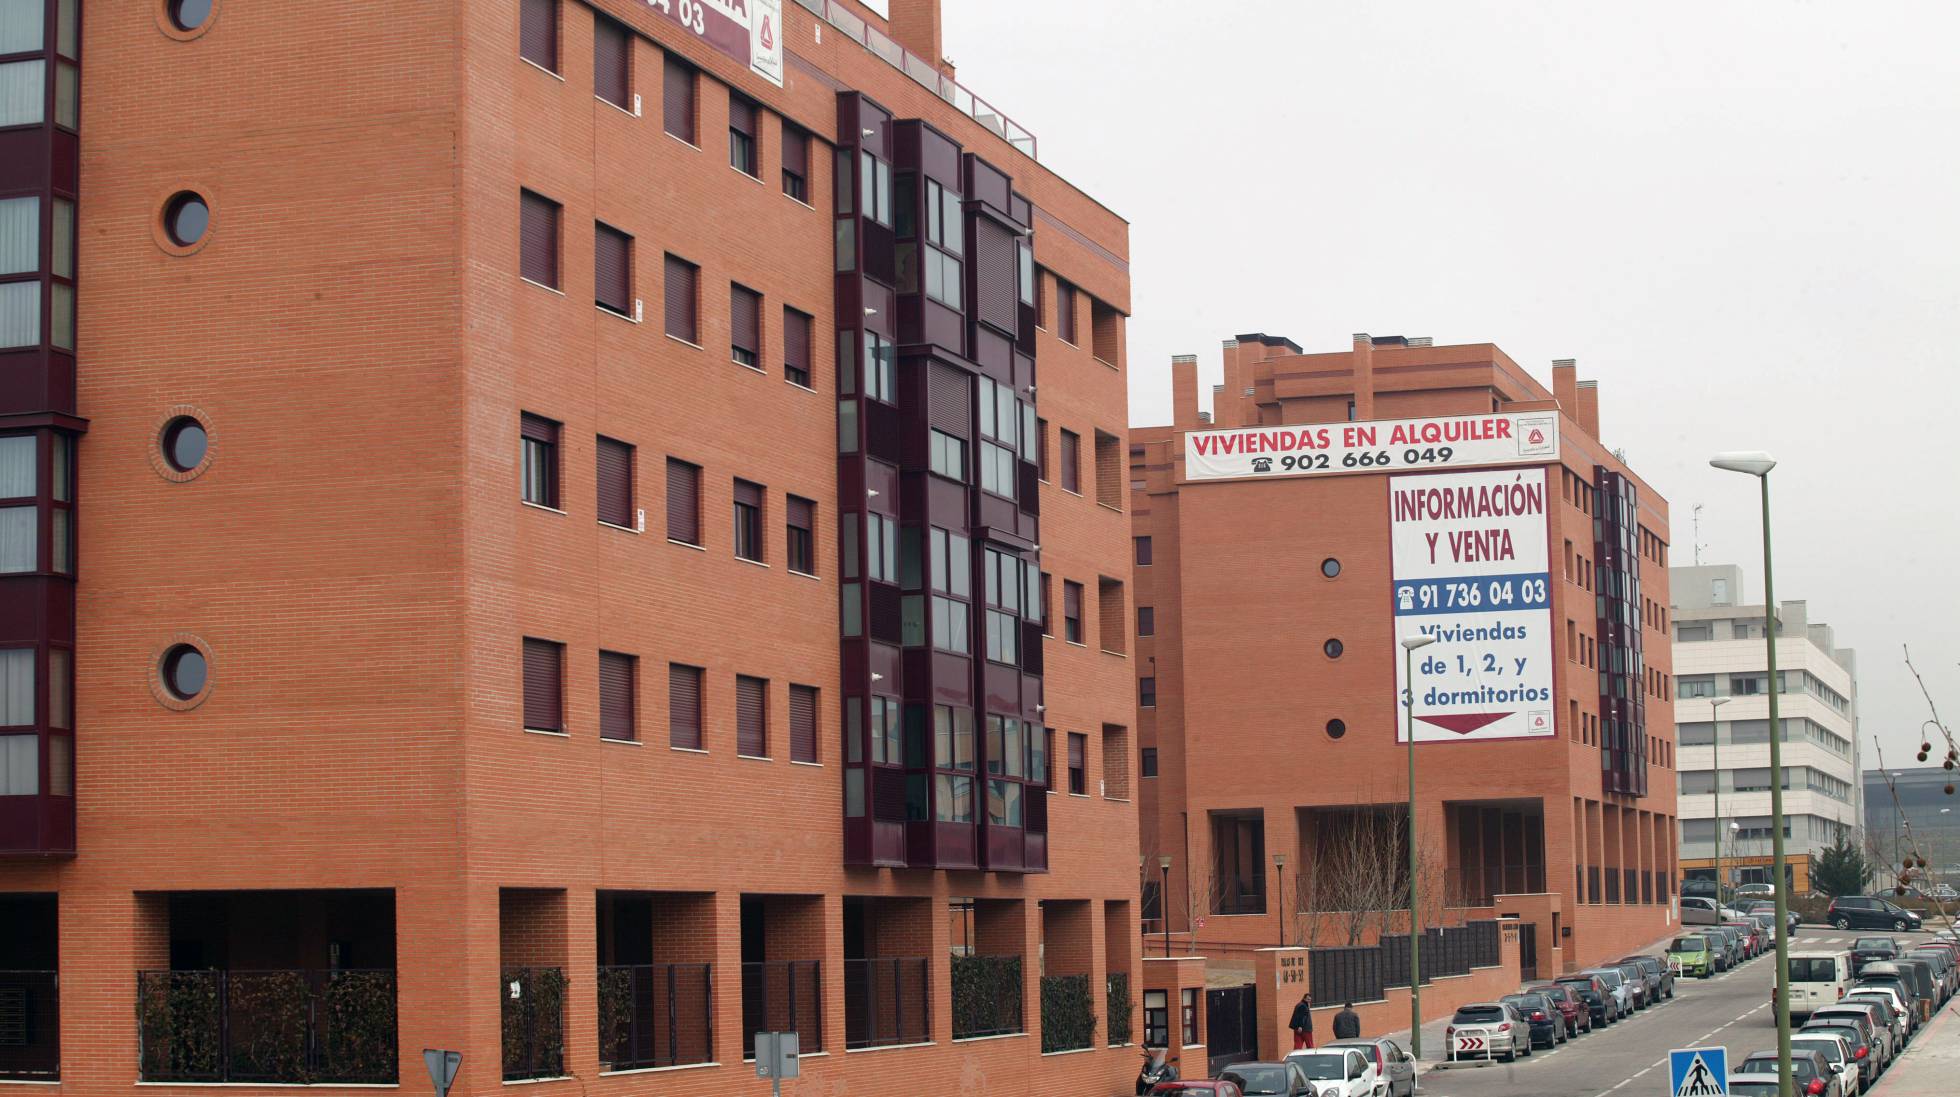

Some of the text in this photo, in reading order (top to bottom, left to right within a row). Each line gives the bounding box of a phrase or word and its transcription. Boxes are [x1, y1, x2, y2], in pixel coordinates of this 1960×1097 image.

[679, 0, 705, 35] 03
[1193, 418, 1511, 455] VIVIENDAS EN ALQUILER
[1281, 447, 1453, 472] 902 666 049
[1394, 473, 1542, 522] INFORMACIÓN
[1426, 529, 1515, 564] Y VENTA
[1420, 580, 1546, 608] 91 736 04 03
[1420, 621, 1526, 643] Viviendas
[1421, 654, 1526, 676] de 1, 2, y
[1402, 683, 1548, 708] 3 dormitorios
